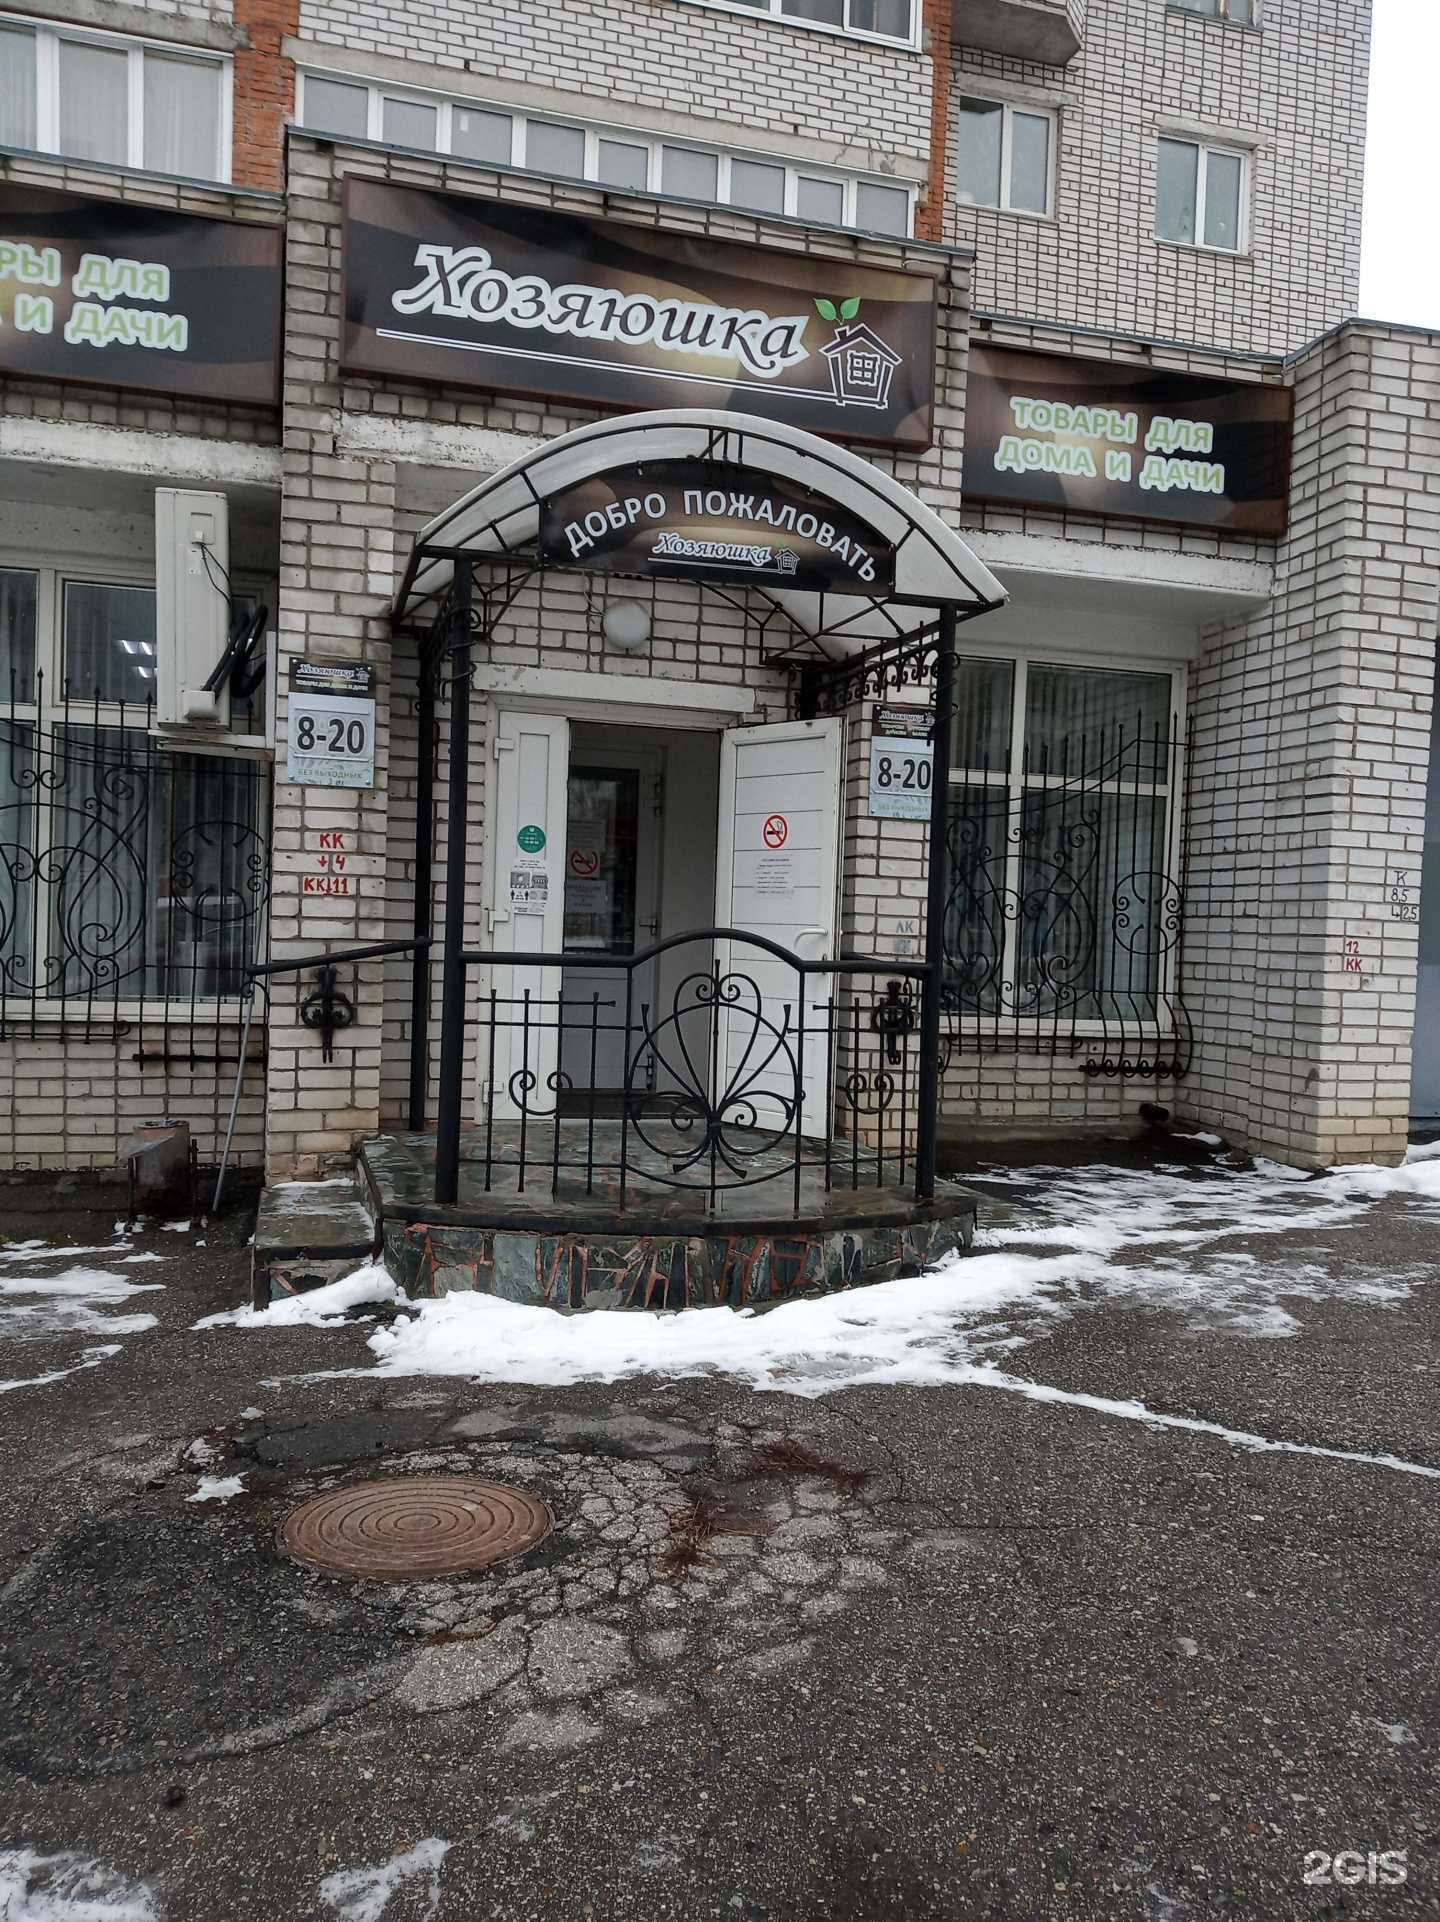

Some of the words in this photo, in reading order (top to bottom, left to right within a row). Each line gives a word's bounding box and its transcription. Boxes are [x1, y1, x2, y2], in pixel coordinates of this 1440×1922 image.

[72, 253, 170, 302] ДЛЯ
[15, 293, 53, 334] И
[65, 301, 188, 351] ДАЧИ
[392, 245, 809, 378] Хозяюшка
[1010, 396, 1138, 443] ТОВАРЫ
[1145, 416, 1213, 454] ДЛЯ
[994, 435, 1096, 477] ДОМА
[1105, 450, 1131, 482] И
[1139, 455, 1225, 494] ДАЧИ
[563, 493, 666, 557] ДОБРО
[683, 490, 876, 582] ПОЖАЛОВАТЬ
[652, 532, 773, 567] Хозяюшка
[297, 716, 365, 754] 8-20
[878, 757, 931, 790] 8-20
[1346, 941, 1359, 953] 12
